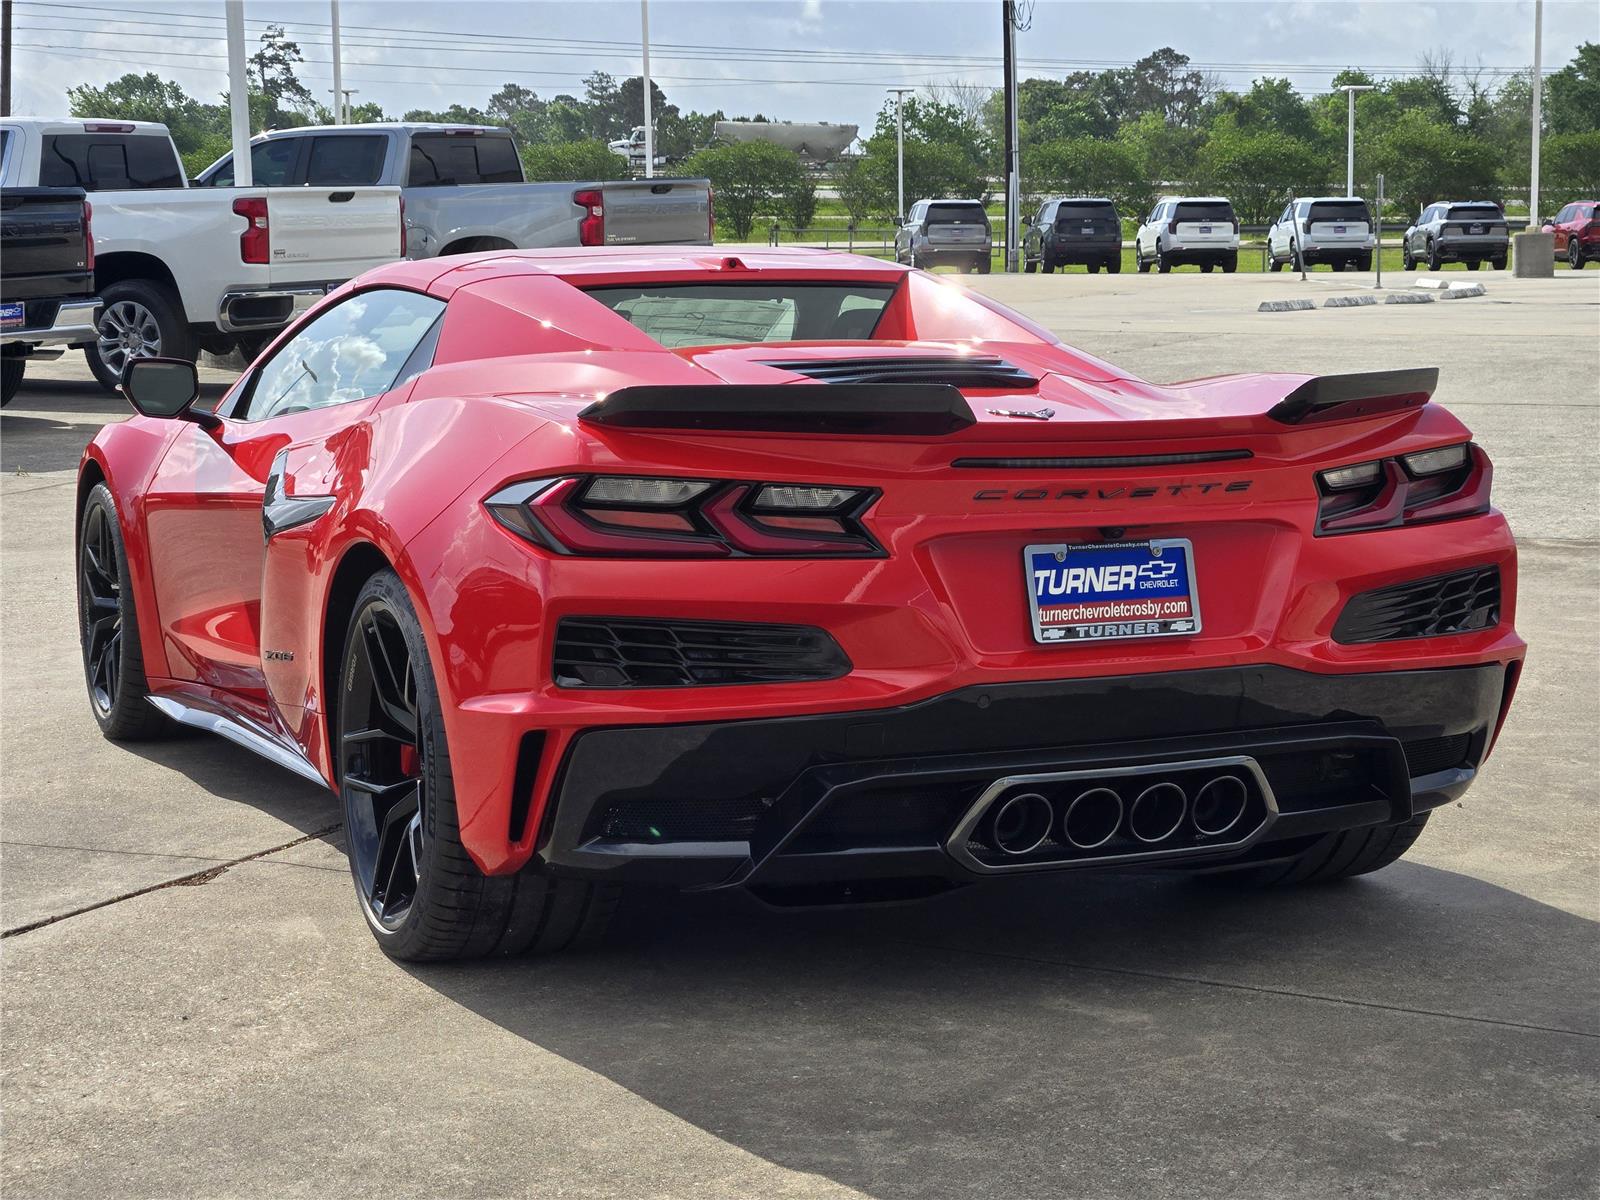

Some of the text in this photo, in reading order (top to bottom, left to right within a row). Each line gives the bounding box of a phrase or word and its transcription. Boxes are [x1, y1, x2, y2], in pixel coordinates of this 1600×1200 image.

[972, 480, 1253, 500] CORVETTE
[1034, 565, 1138, 596] TURNER
[1139, 579, 1178, 589] CHEVROLET
[1039, 600, 1188, 623] turnerchevroletcrosby.com
[1076, 622, 1160, 638] TURNER
